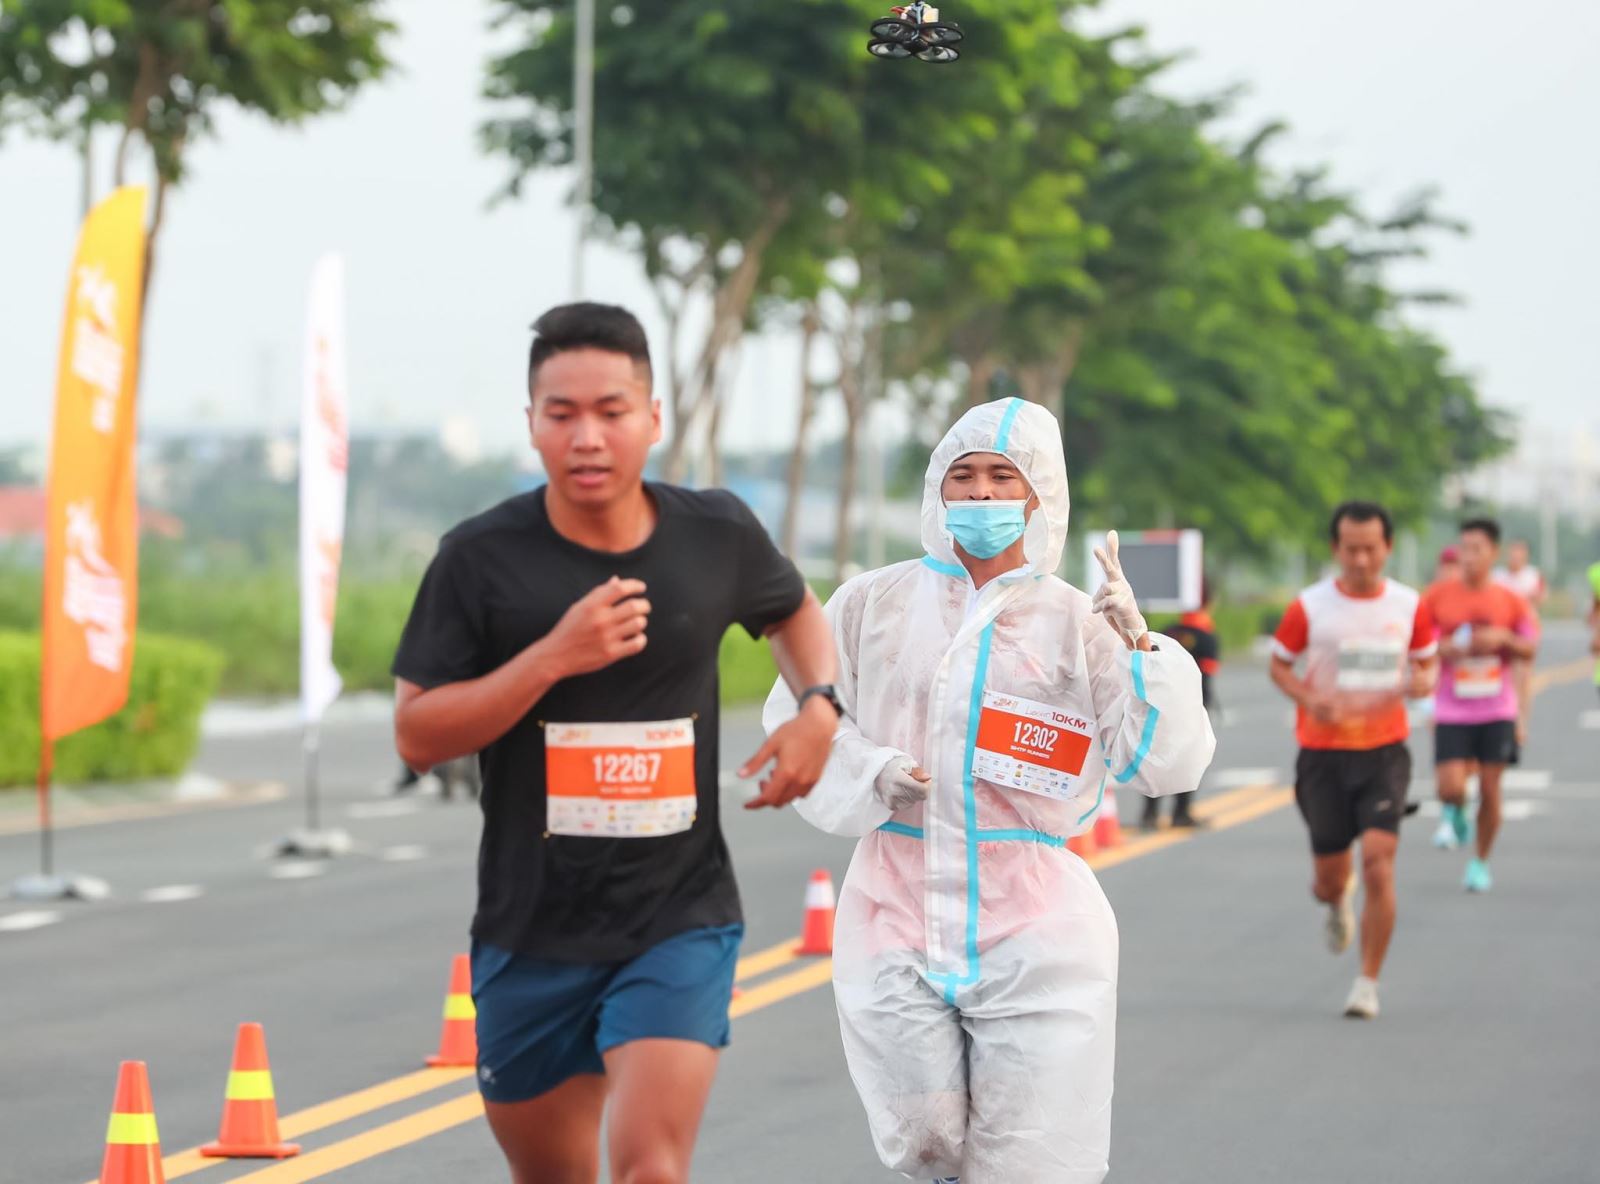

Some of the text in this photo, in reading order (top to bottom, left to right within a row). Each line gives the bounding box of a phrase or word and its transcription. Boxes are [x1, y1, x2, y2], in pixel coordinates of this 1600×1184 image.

[1051, 711, 1087, 730] 10KM
[1013, 721, 1058, 751] 12302
[593, 753, 661, 783] 12267
